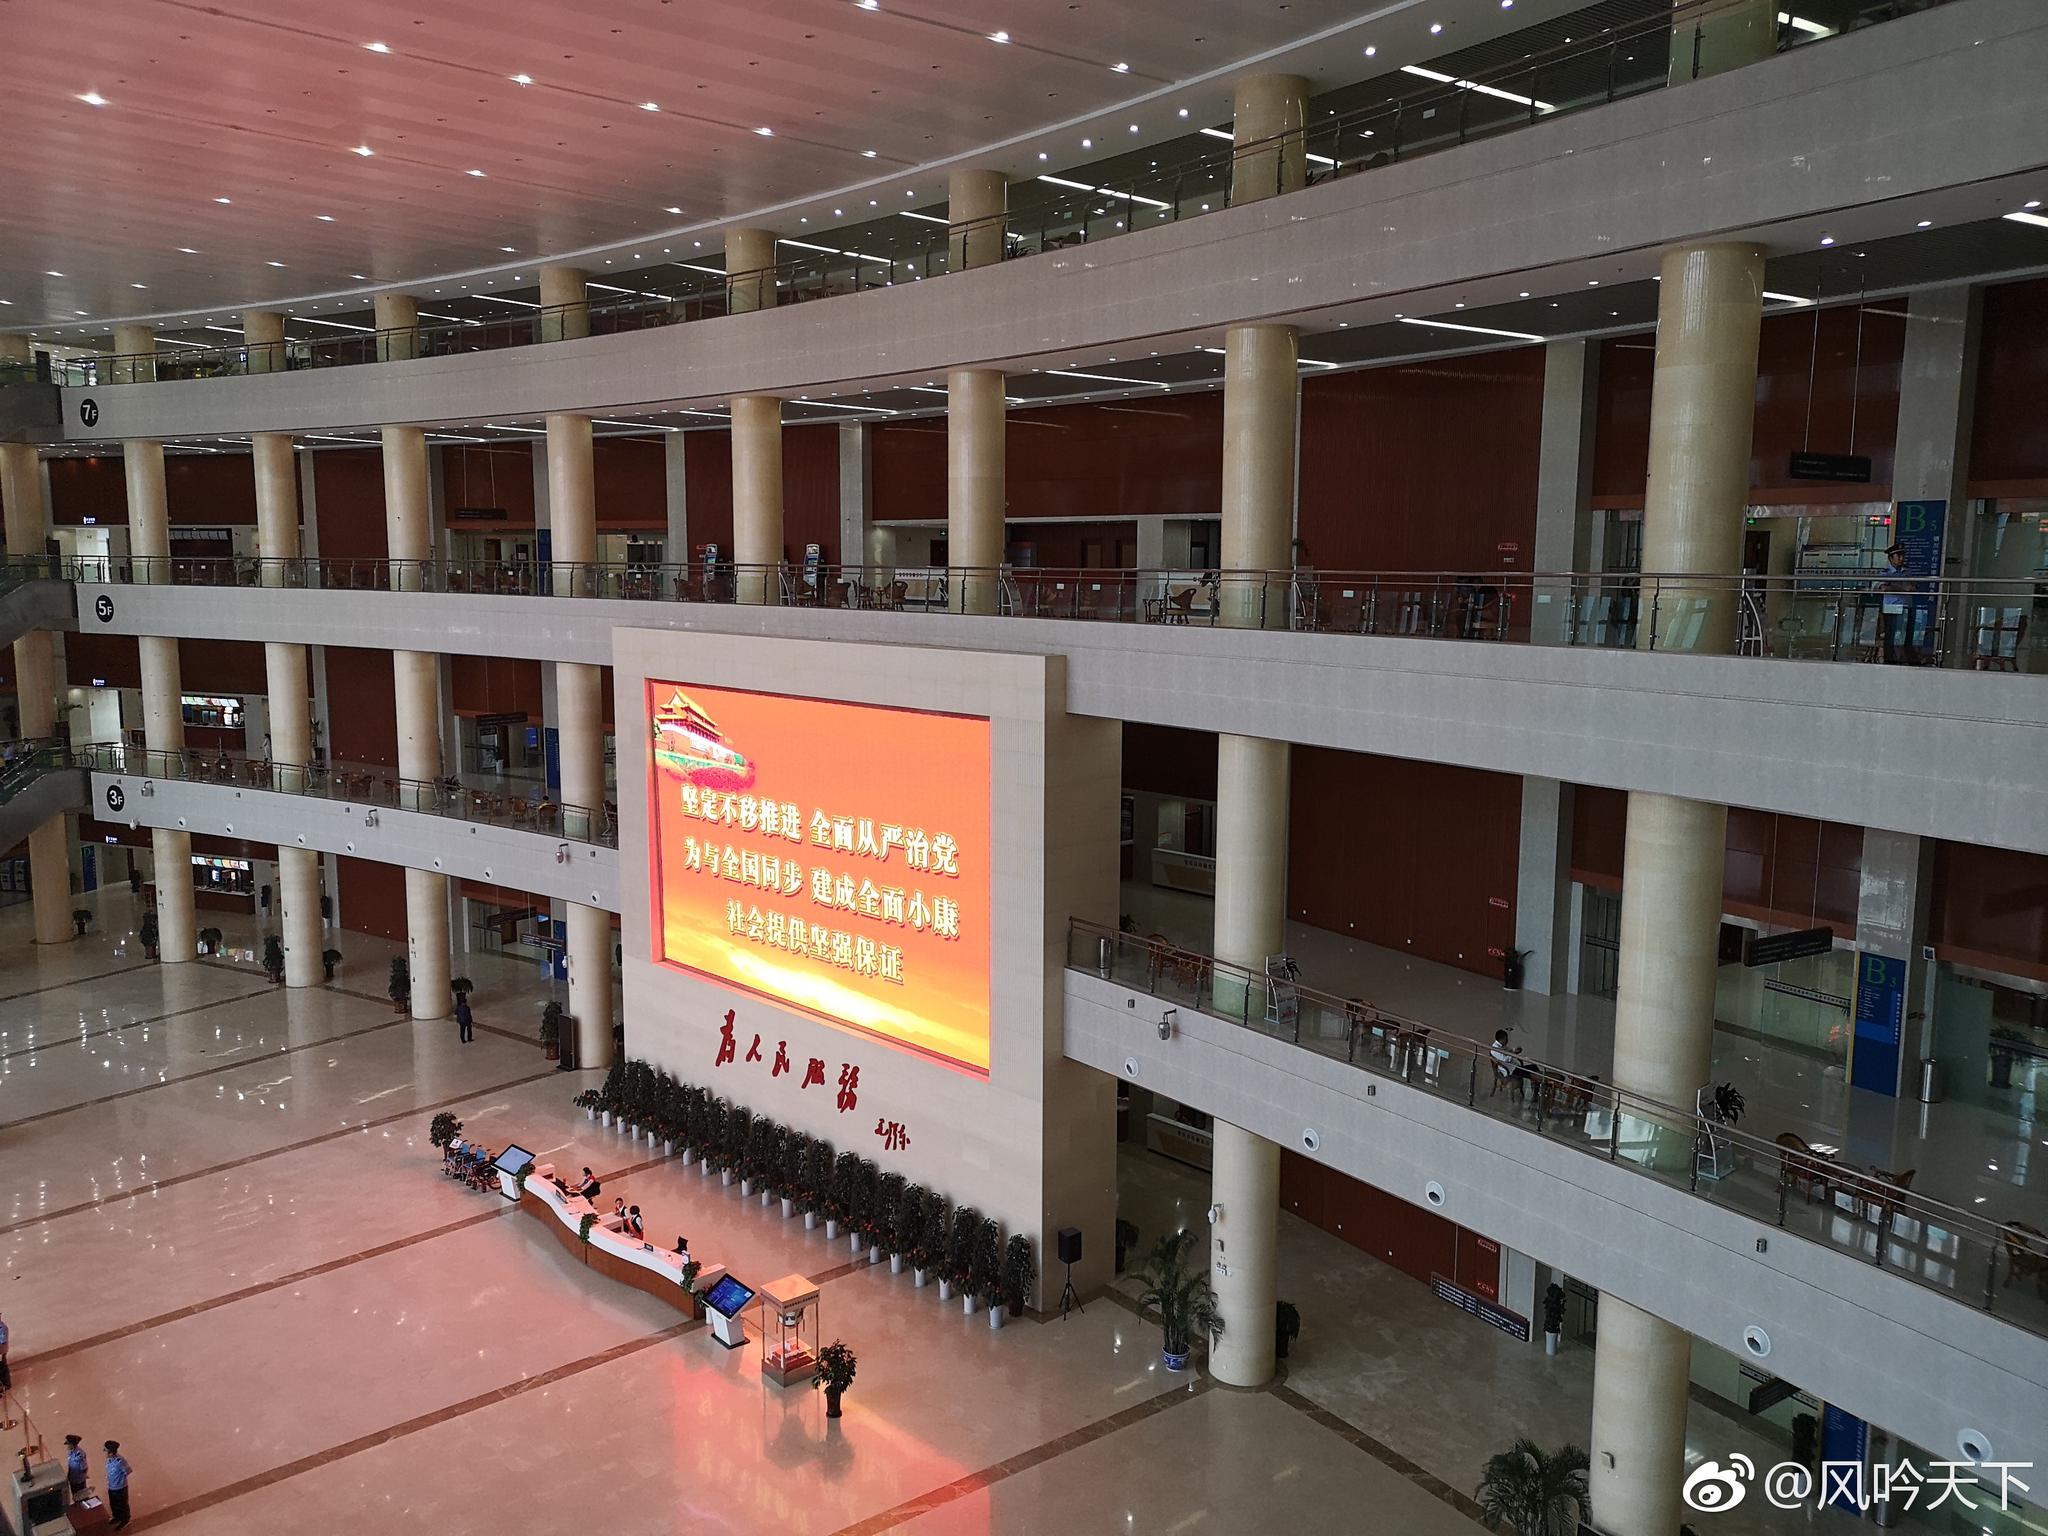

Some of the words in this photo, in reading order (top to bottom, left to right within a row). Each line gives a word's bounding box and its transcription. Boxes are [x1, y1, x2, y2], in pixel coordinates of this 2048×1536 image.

[82, 404, 97, 420] 7F
[98, 600, 112, 616] 5F
[109, 790, 123, 806] 3F
[681, 783, 802, 841] 坚定不移推进
[809, 808, 960, 877] 全面从严治党
[684, 835, 803, 896] 为与全国同步
[810, 867, 960, 940] 建成全面小康
[725, 898, 904, 985] 社会提供坚强保证
